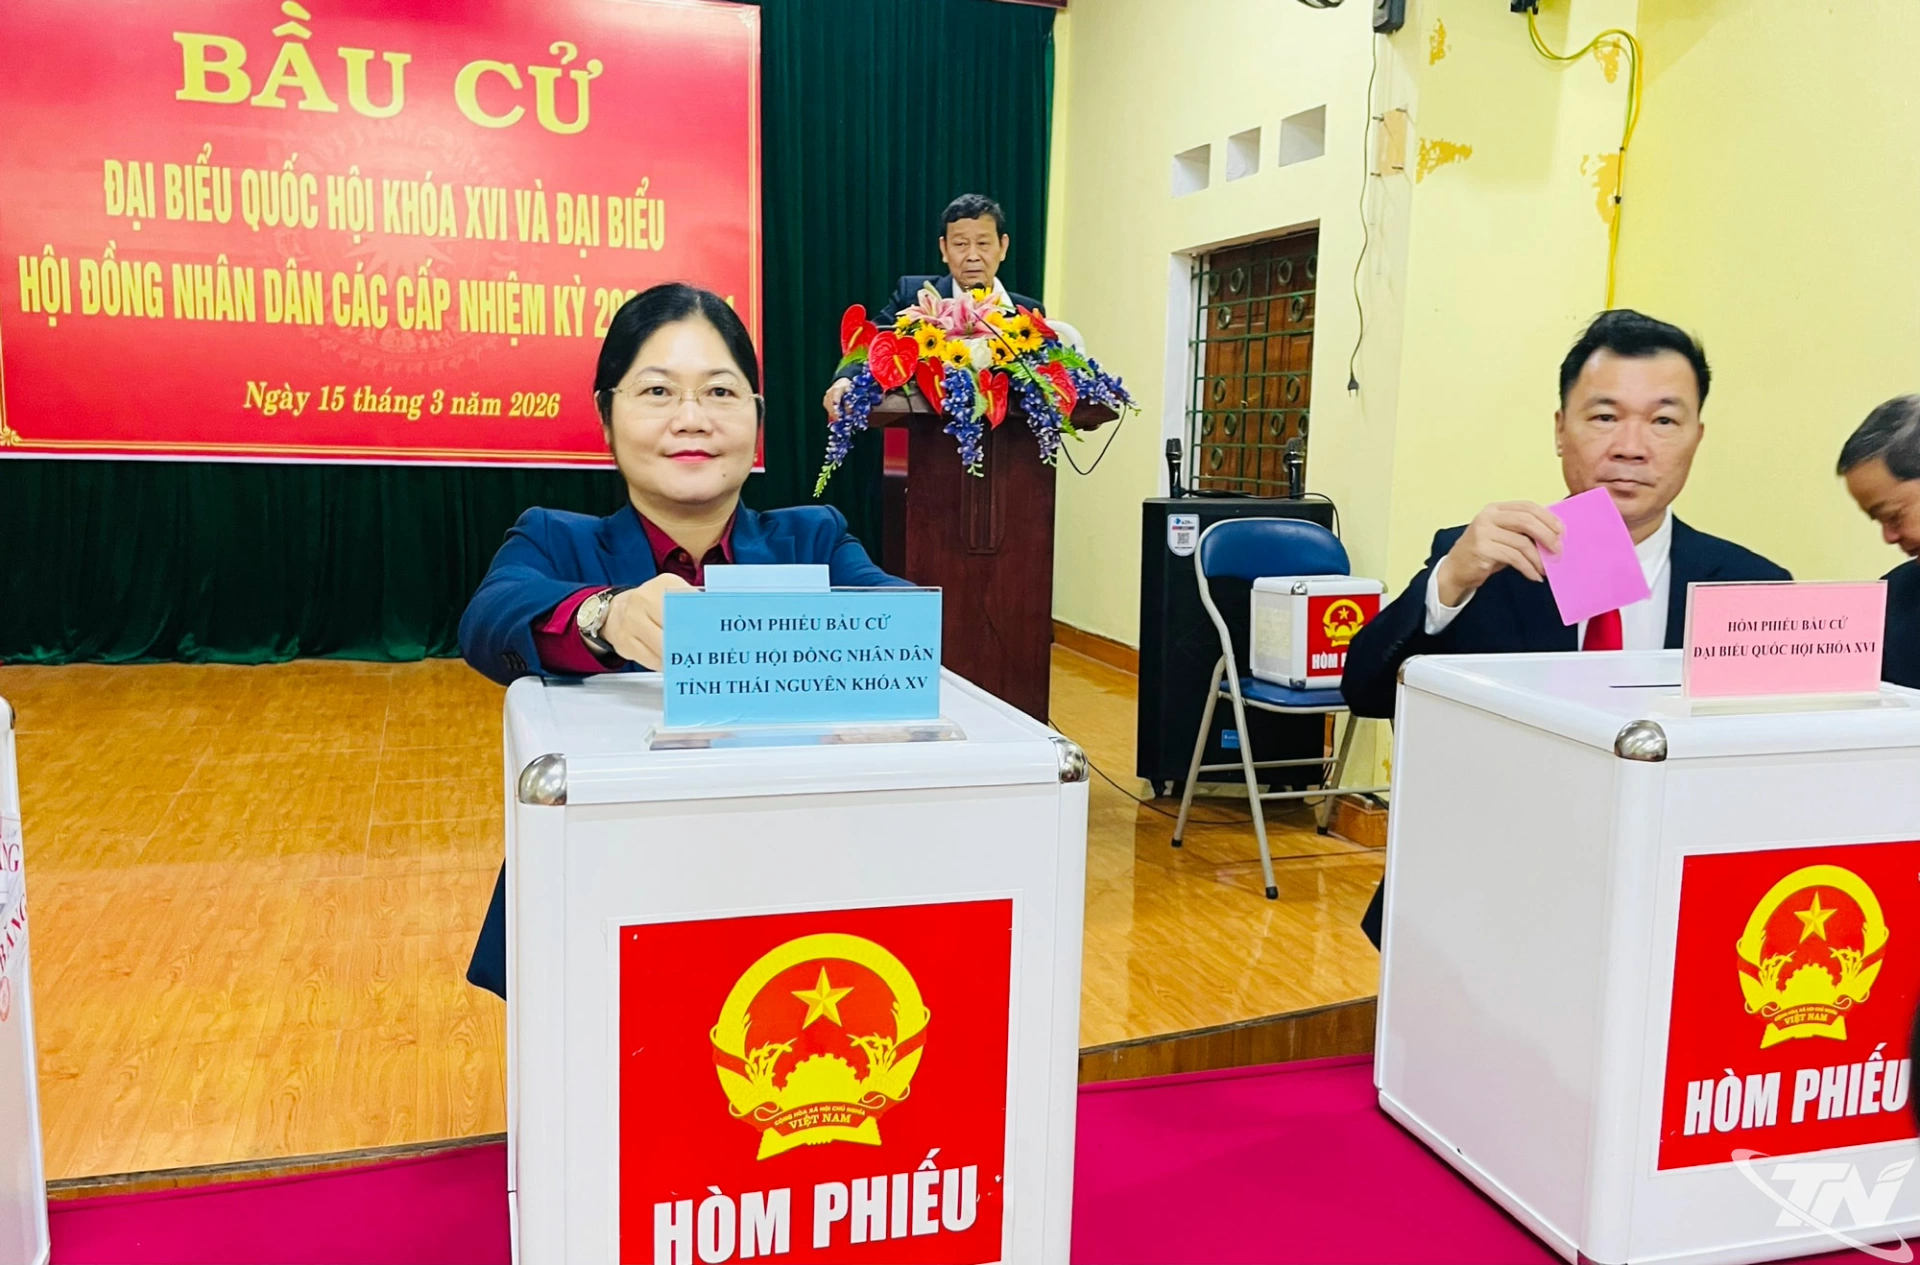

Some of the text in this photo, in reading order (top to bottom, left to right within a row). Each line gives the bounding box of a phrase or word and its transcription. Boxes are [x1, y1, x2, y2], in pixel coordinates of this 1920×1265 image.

[172, 0, 603, 134] BẦU CỬ
[104, 142, 665, 258] ĐẠI BIỂU QUỐC HỘI KHÓA XVI VÀ ĐẠI BIỂU
[18, 243, 72, 327] HỘI
[80, 240, 164, 318] ĐỒNG
[172, 253, 256, 322] NHÂN
[263, 257, 324, 325] DÂN
[332, 261, 389, 329] CÁC
[396, 259, 450, 331] CẤP
[459, 270, 546, 346] NHIỆM
[553, 274, 587, 338] KỲ
[243, 381, 560, 420] Ngày 15 tháng 3 năm 2026
[720, 614, 762, 632] HÒM
[1728, 618, 1757, 632] HÒM
[671, 652, 702, 668] ĐẠI
[755, 648, 787, 666] HỘI
[847, 645, 895, 662] NHÂN
[899, 644, 934, 661] DÂN
[1854, 641, 1875, 653] XVI
[1311, 651, 1338, 669] HÒM
[676, 673, 928, 695] TỈNH THÁI NGUYÊN KHÓA XV
[1683, 1043, 1912, 1135] HÒM PHIẾU
[788, 1113, 851, 1129] VIỆT NAM
[653, 1148, 978, 1265] HÒM PHIẾU
